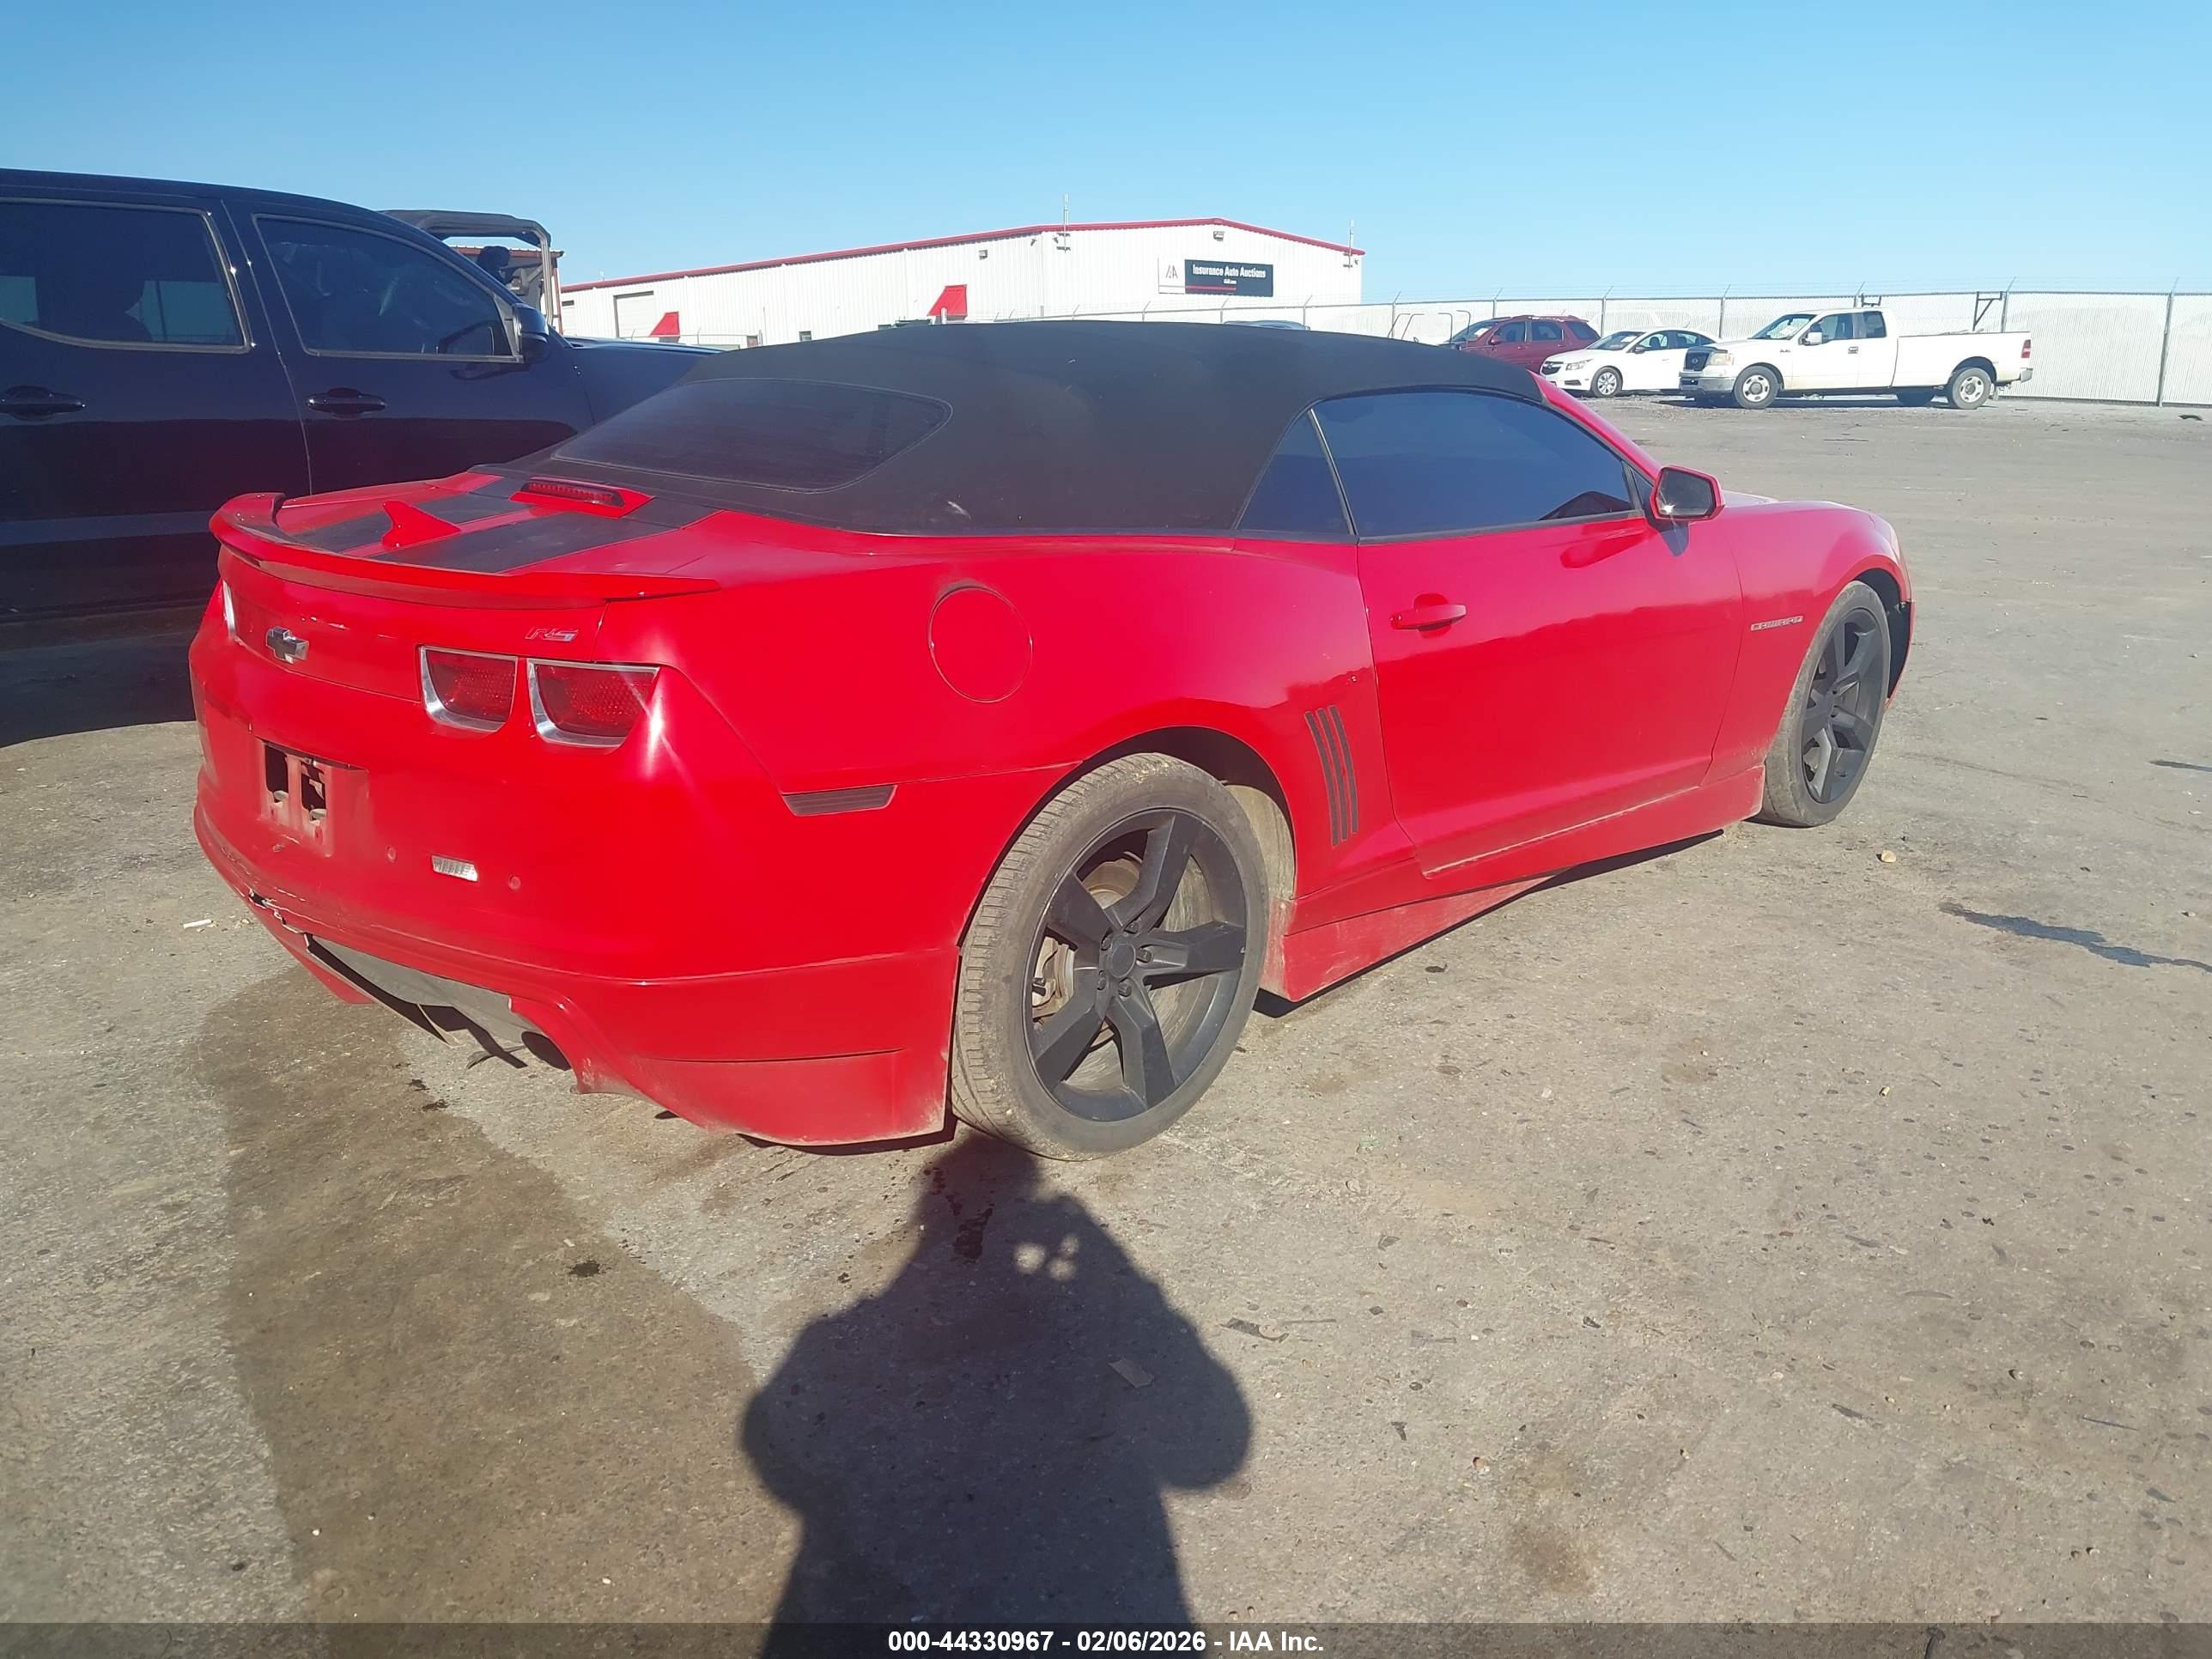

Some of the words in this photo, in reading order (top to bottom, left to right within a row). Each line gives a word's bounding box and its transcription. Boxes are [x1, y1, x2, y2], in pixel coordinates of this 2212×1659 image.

[1192, 264, 1224, 276] Insurance
[1224, 265, 1239, 276] Auto
[1239, 266, 1267, 278] Auctions
[525, 627, 579, 642] RS
